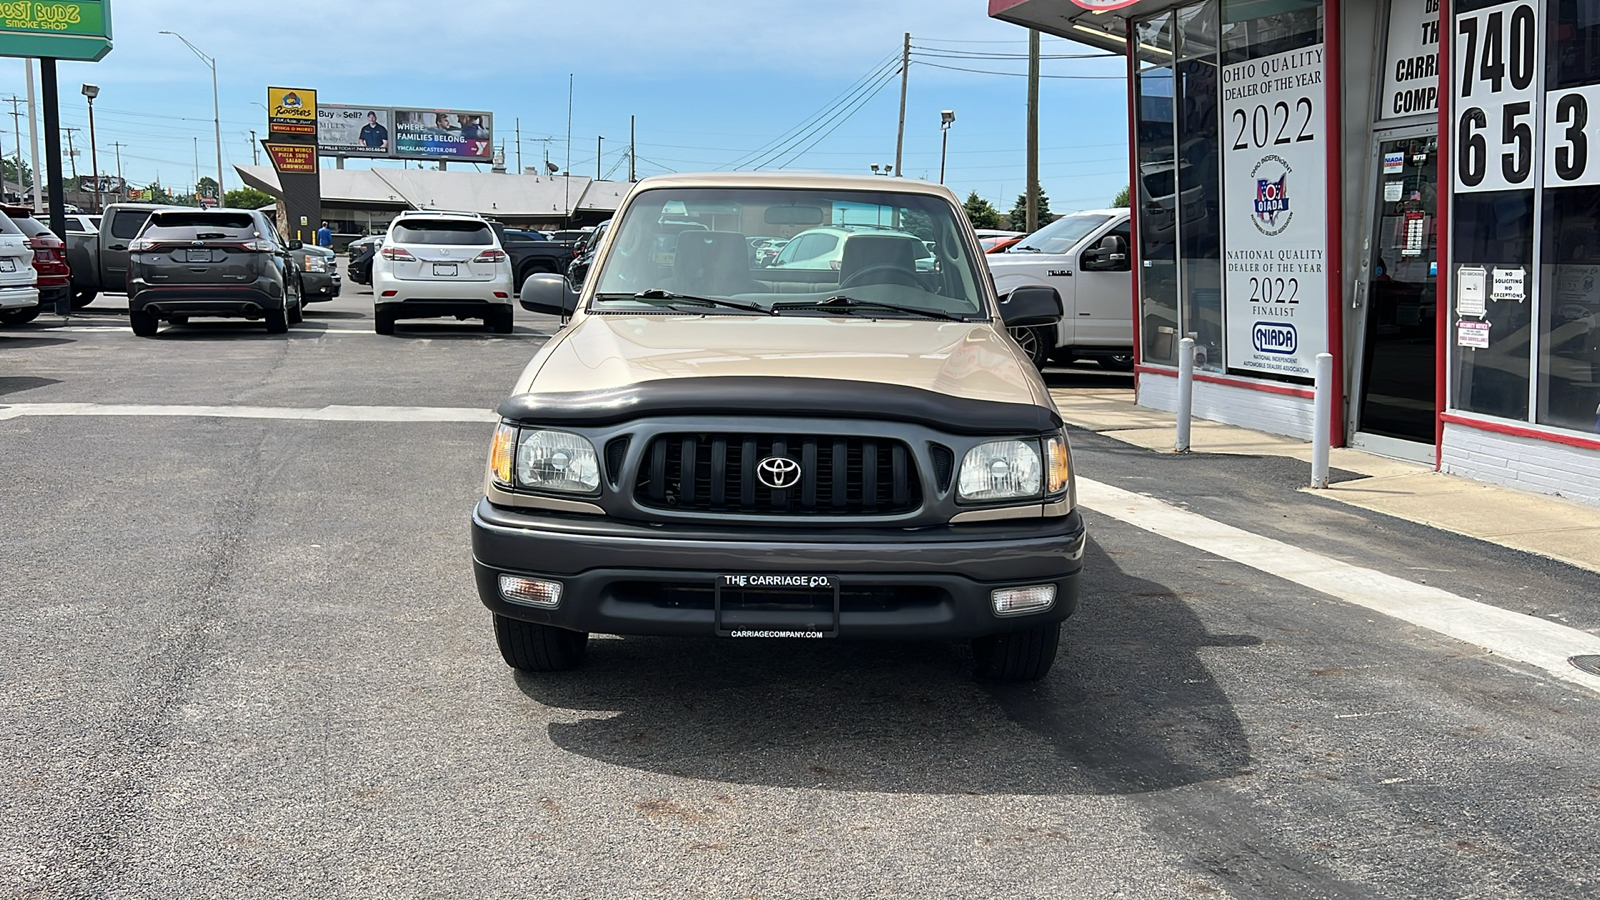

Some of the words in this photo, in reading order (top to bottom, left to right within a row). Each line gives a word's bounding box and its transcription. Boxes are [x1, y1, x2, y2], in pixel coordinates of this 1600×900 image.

[6, 20, 39, 29] SMOKE
[41, 22, 68, 30] SHOP
[1459, 4, 1535, 97] 740
[1224, 64, 1256, 84] OHIO
[1261, 49, 1323, 77] QUALITY
[1225, 83, 1258, 101] DEALER
[1260, 80, 1272, 94] OF
[1274, 76, 1294, 92] THE
[1295, 70, 1322, 88] YEAR
[274, 105, 311, 117] Roosters
[318, 111, 334, 119] Buy
[343, 111, 362, 119] Sell?
[396, 122, 425, 131] WHERE
[1232, 96, 1314, 150] 2022
[397, 133, 432, 141] FAMILIES
[434, 135, 468, 143] BELONG.
[1250, 161, 1261, 178] OHIO
[1260, 154, 1292, 174] INDEPENDENT
[1258, 200, 1283, 212] OIADA
[1227, 250, 1274, 260] NATIONAL
[1278, 250, 1323, 261] QUALITY
[1228, 263, 1260, 272] DEALER
[1263, 263, 1274, 272] OF
[1277, 264, 1294, 273] THE
[1298, 264, 1322, 273] YEAR
[1249, 277, 1299, 304] 2022
[1252, 306, 1295, 317] FINALIST
[1256, 328, 1293, 348] NIADA
[724, 576, 747, 585] THE
[750, 576, 808, 585] CARRIAGE
[810, 576, 830, 586] CO.
